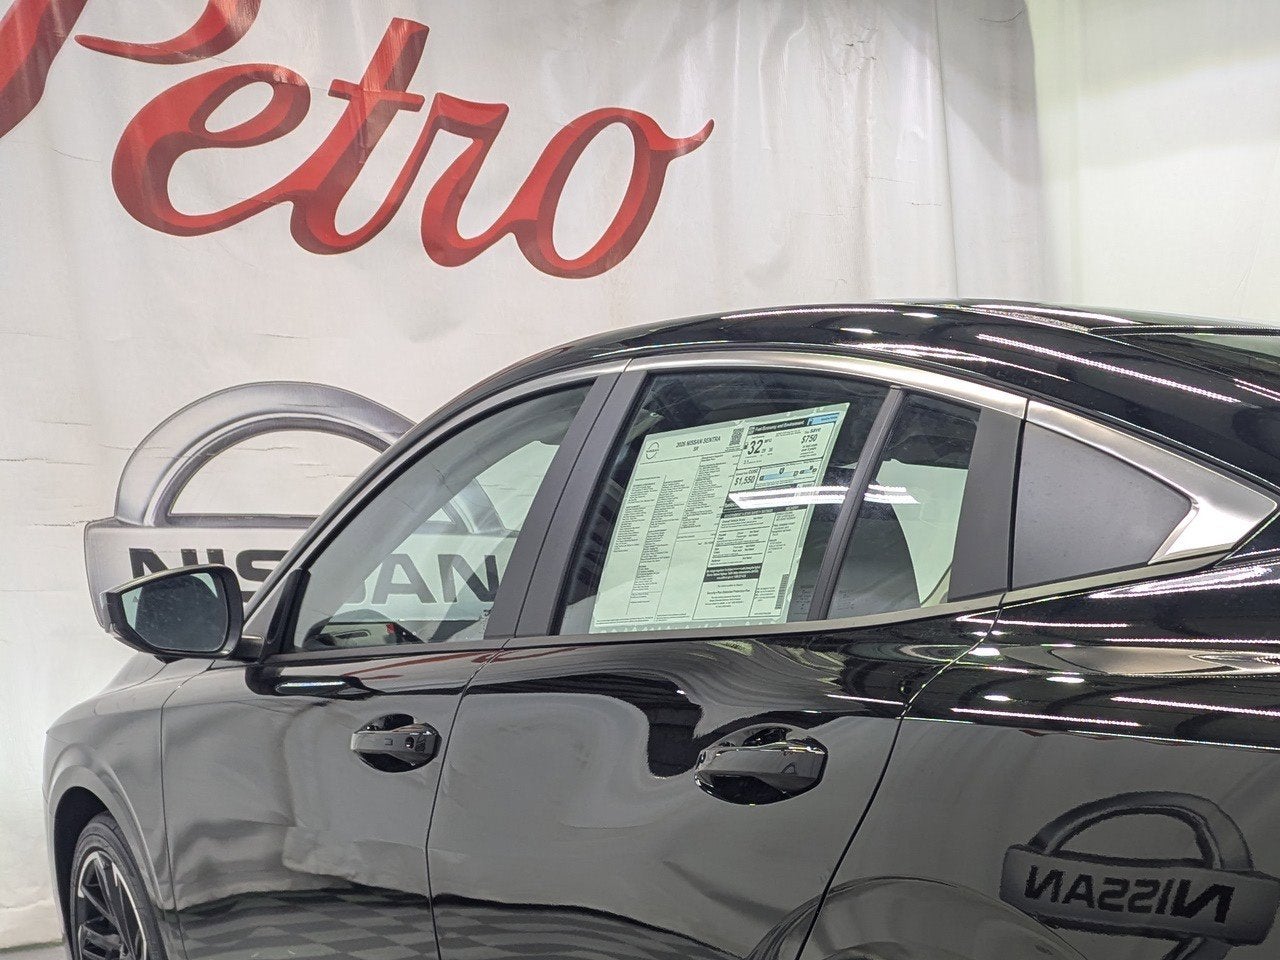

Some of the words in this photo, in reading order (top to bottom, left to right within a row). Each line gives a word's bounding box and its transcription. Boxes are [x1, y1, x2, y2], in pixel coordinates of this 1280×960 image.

[0, 0, 714, 279] etro
[801, 434, 818, 444] $750
[748, 439, 763, 455] 32
[734, 475, 756, 486] $1,550
